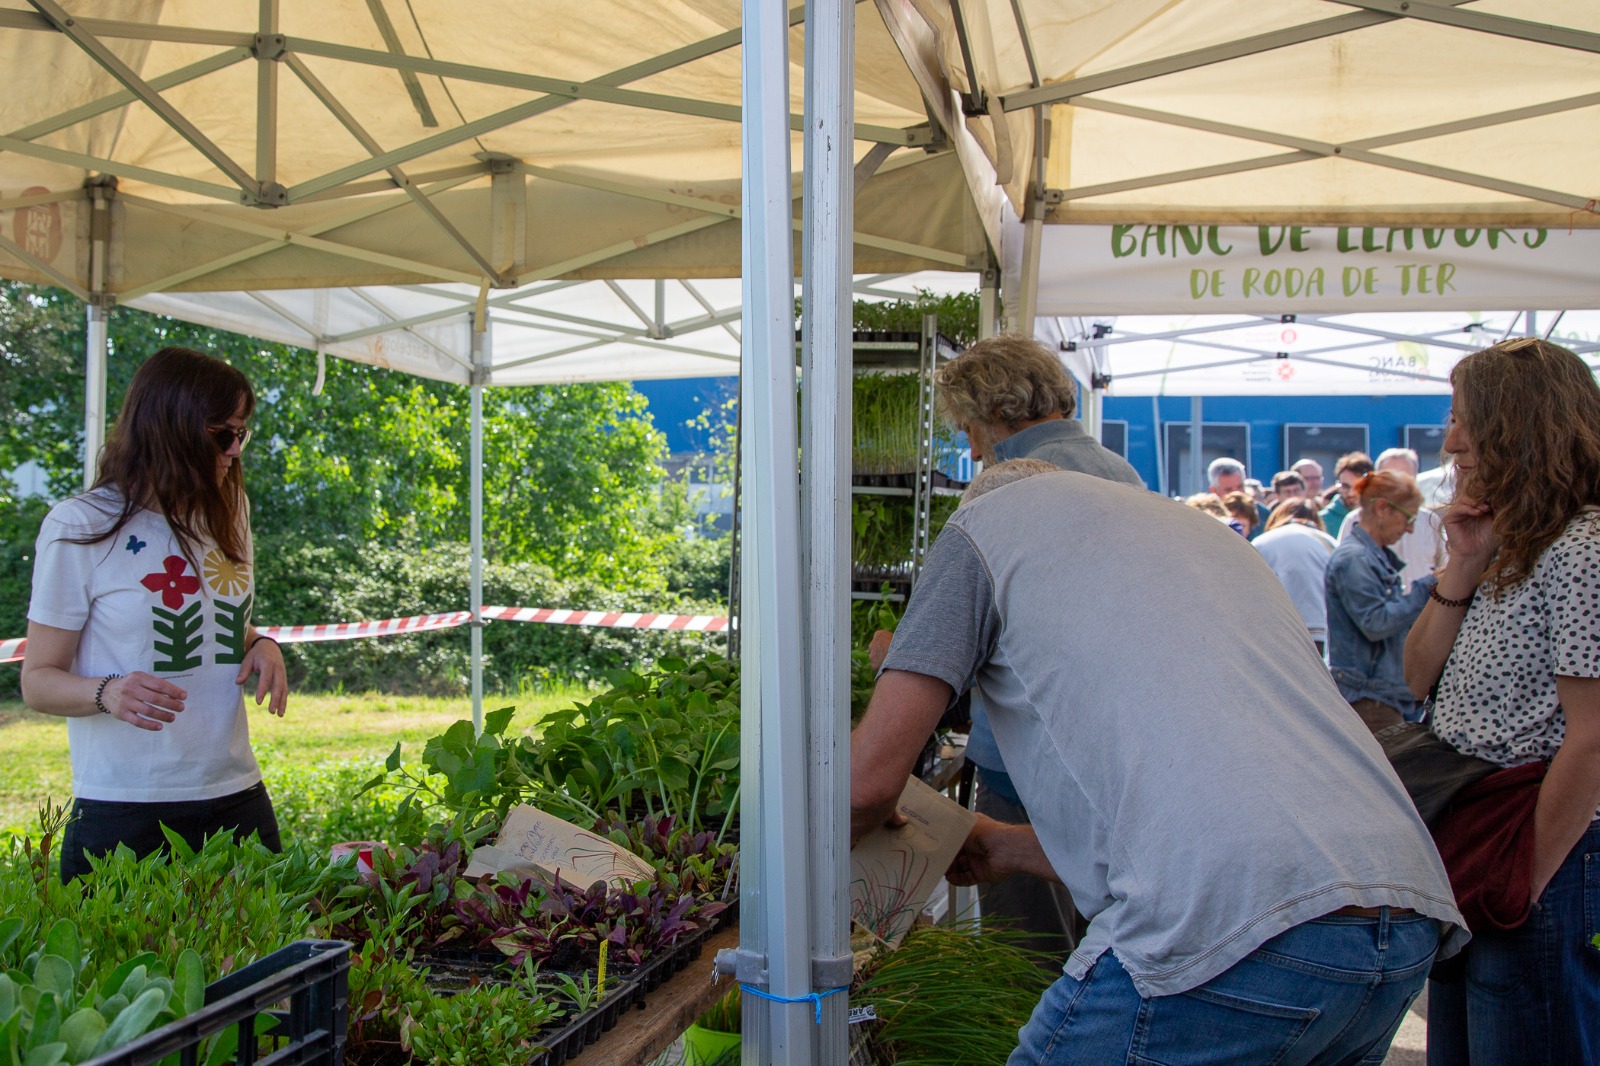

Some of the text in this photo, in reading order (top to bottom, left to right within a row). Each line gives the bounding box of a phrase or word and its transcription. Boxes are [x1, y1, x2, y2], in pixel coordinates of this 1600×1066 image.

[1111, 224, 1233, 258] BANC
[1258, 225, 1311, 256] DE
[1190, 263, 1456, 299] DE RODA DE TER
